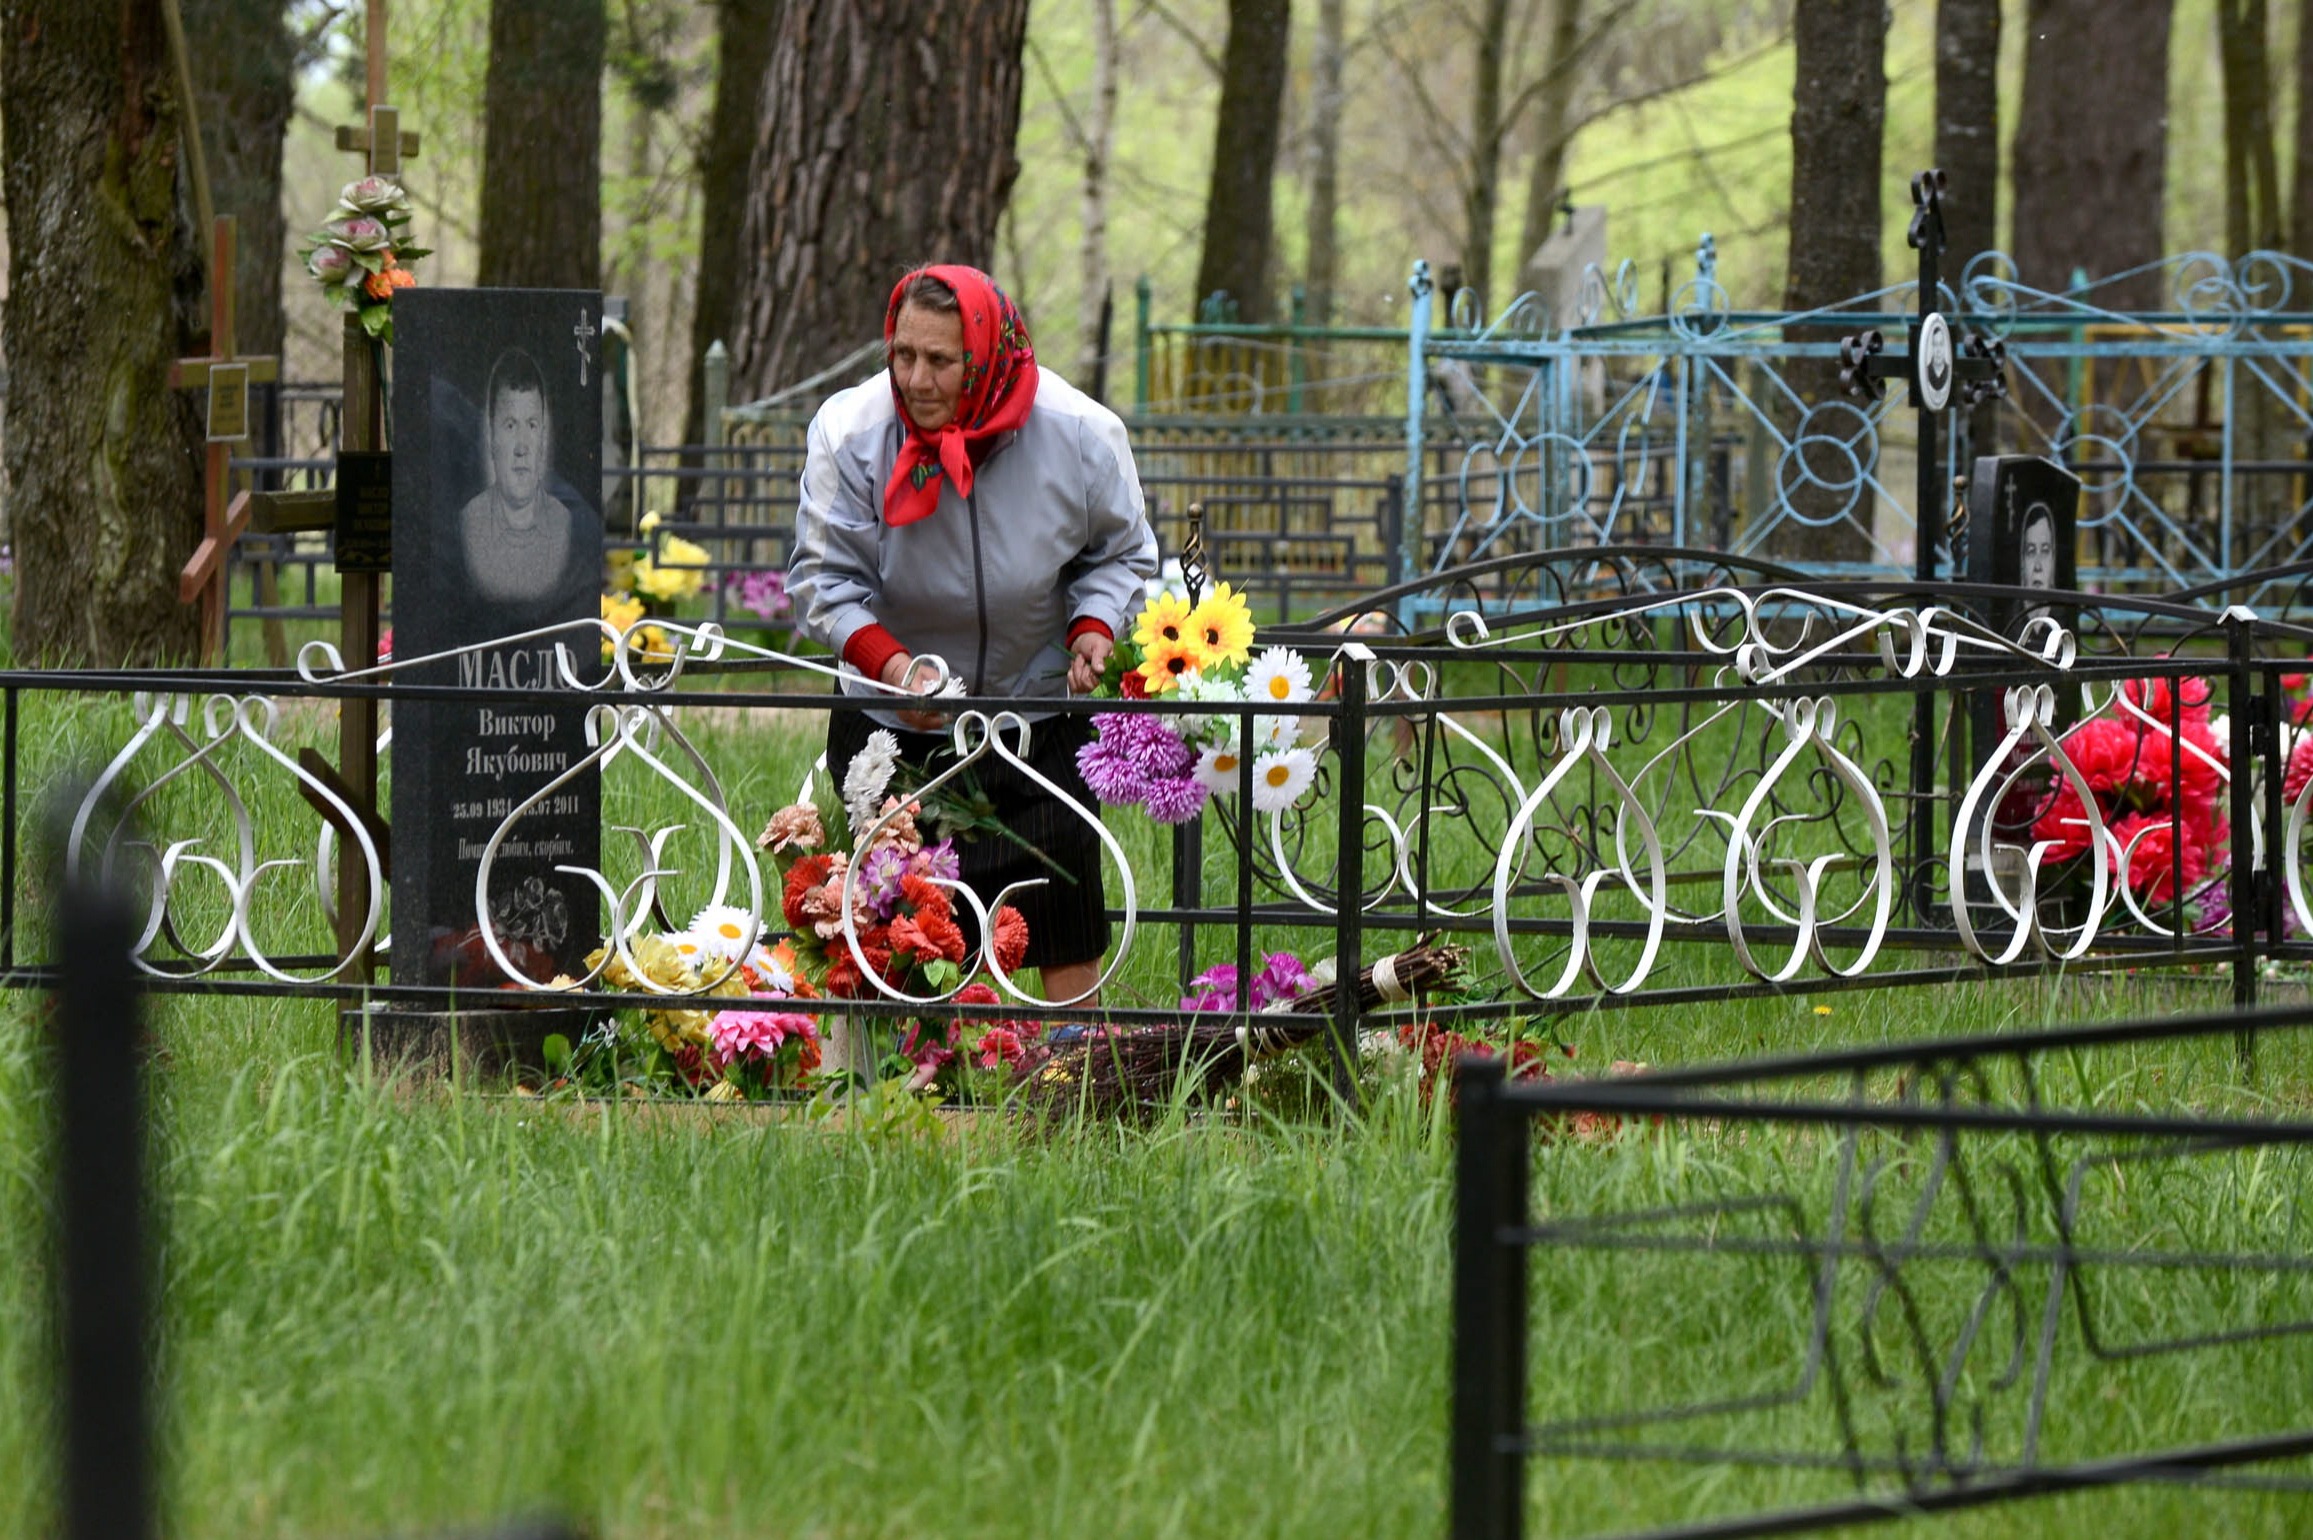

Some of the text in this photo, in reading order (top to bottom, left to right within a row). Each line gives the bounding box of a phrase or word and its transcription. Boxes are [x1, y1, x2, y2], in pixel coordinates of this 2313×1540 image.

[478, 708, 556, 741] Виктор
[465, 744, 568, 781] Якубович
[553, 795, 579, 814] 2011
